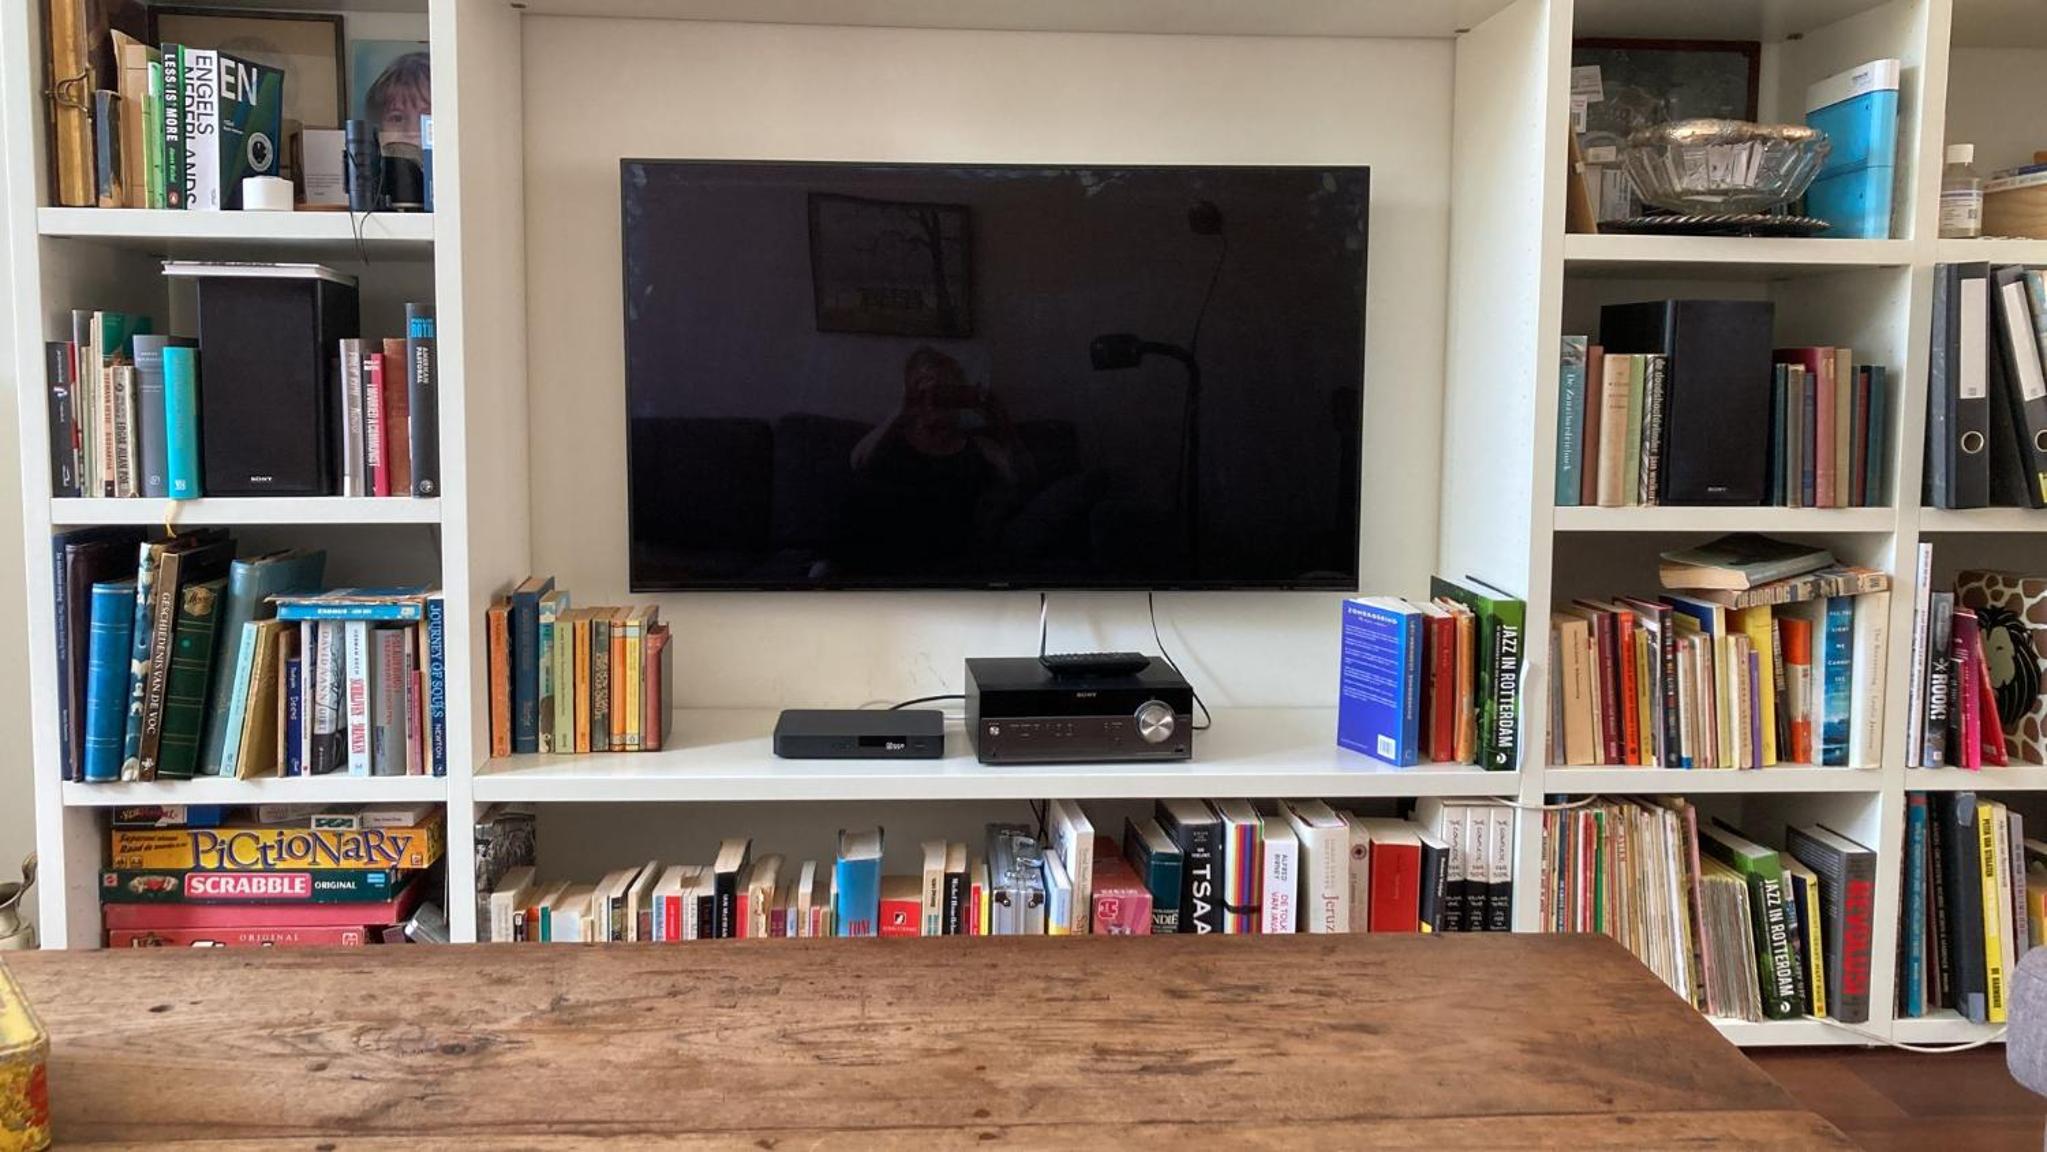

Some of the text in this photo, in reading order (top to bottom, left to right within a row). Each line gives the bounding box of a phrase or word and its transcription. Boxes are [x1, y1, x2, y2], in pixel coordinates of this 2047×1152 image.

[164, 54, 179, 142] LESS IS MORE
[196, 55, 214, 135] ENGELS
[220, 57, 258, 106] EN
[184, 66, 197, 205] NEDERLANDS
[147, 592, 172, 735] GESCHIEDENIS VAN DE VOC
[320, 630, 330, 667] DAVID
[430, 604, 443, 759] JOURNEY OF SOULS NEWTON
[1497, 624, 1517, 748] JAZZ IN ROTTERDAM
[1930, 674, 1948, 721] ROOK!
[1280, 854, 1289, 881] ALFRED
[1982, 818, 1994, 878] PETER VAN STRAATEN
[190, 875, 357, 894] SCRABBLE ORIGINAL
[1191, 864, 1212, 935] TSAA
[1271, 892, 1279, 913] VAN
[1152, 913, 1179, 926] NDIË
[1280, 894, 1289, 932] DE TOLK
[1321, 893, 1340, 932] Jeruz
[239, 933, 299, 943] ORIGINAL
[1764, 878, 1794, 997] JAZZ IN ROTTERDAM
